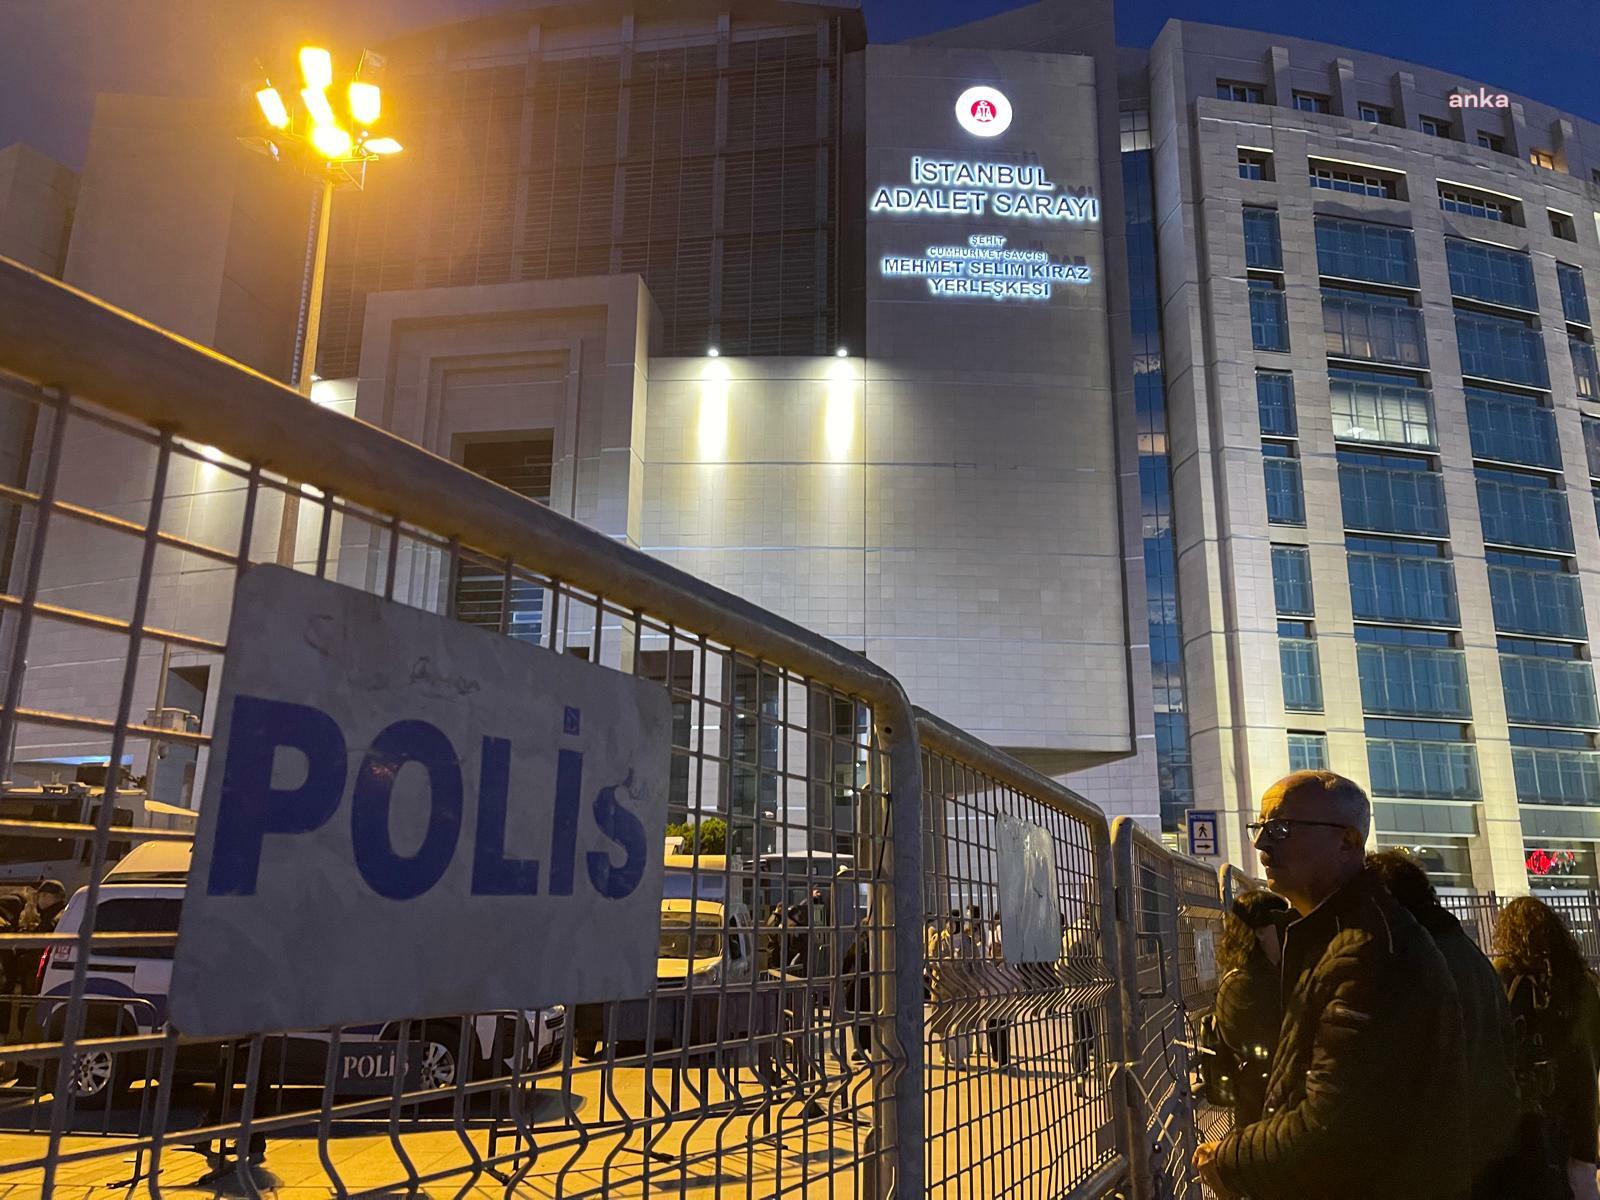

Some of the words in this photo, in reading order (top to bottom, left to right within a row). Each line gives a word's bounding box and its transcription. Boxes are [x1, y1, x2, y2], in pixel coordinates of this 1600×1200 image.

[913, 157, 1052, 188] İSTANBUL
[873, 188, 986, 212] ADALET
[994, 194, 1098, 218] SARAYI
[884, 258, 964, 274] MEHMET
[970, 260, 1024, 277] SELİM
[1031, 262, 1090, 280] KİRAZ
[930, 278, 1049, 297] YERLEŞKESİ
[206, 693, 648, 900] POLİS
